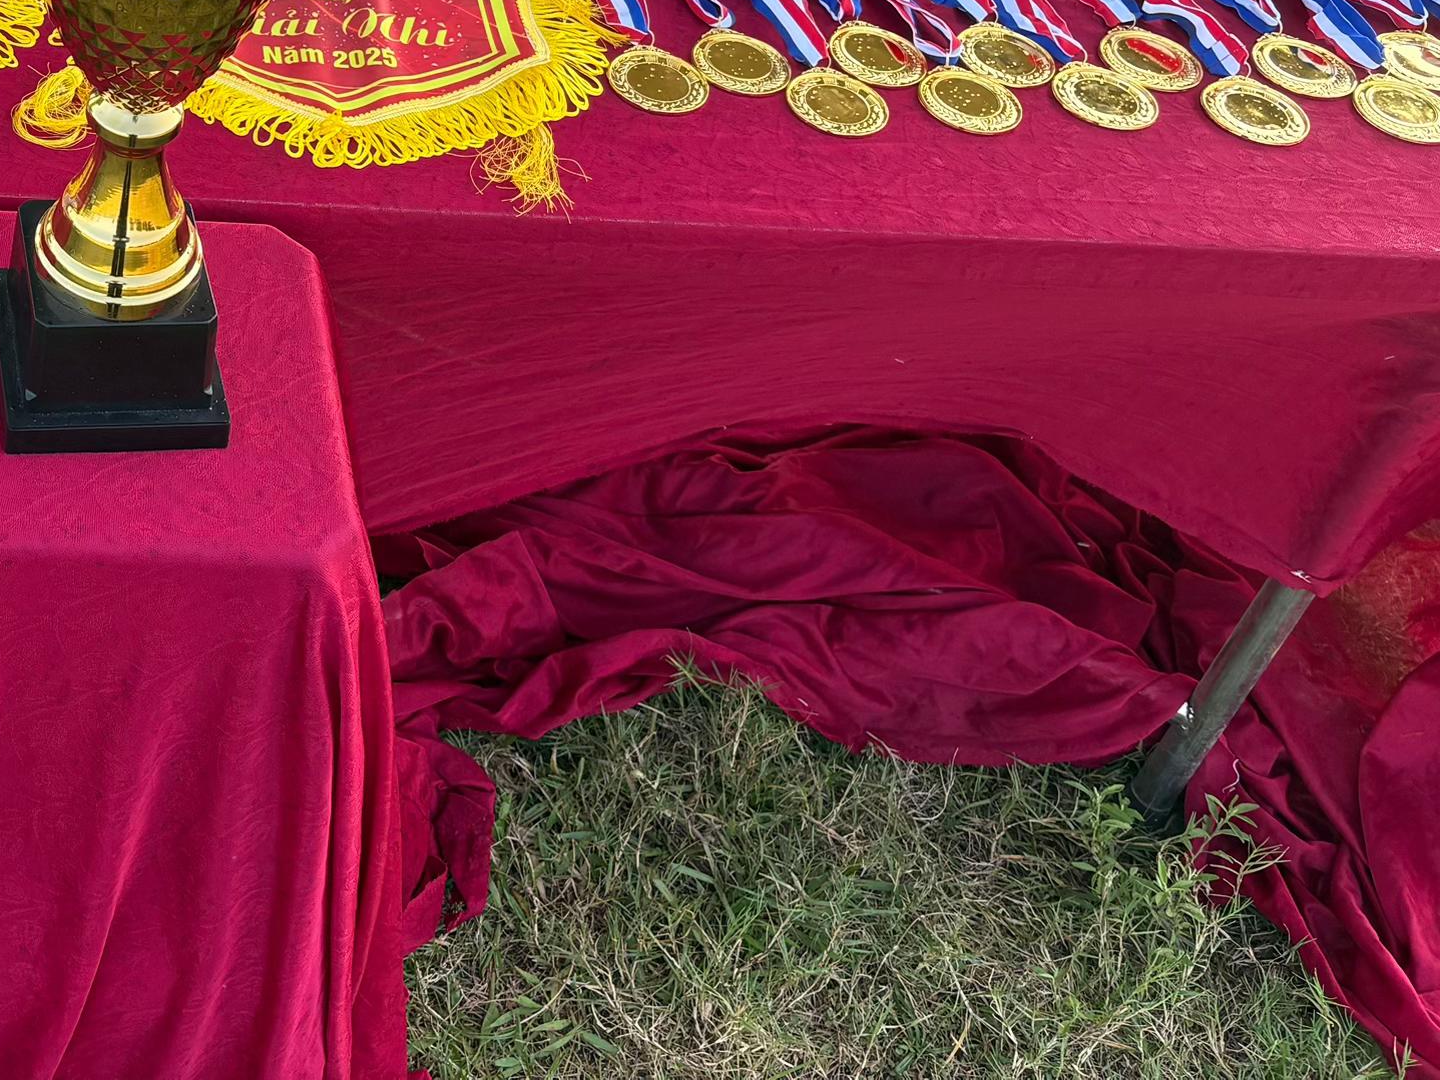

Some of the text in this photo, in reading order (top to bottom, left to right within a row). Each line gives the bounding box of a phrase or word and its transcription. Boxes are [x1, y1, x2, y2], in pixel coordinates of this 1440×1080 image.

[251, 7, 456, 47] iải Nhì
[262, 45, 397, 69] Năm 2025
